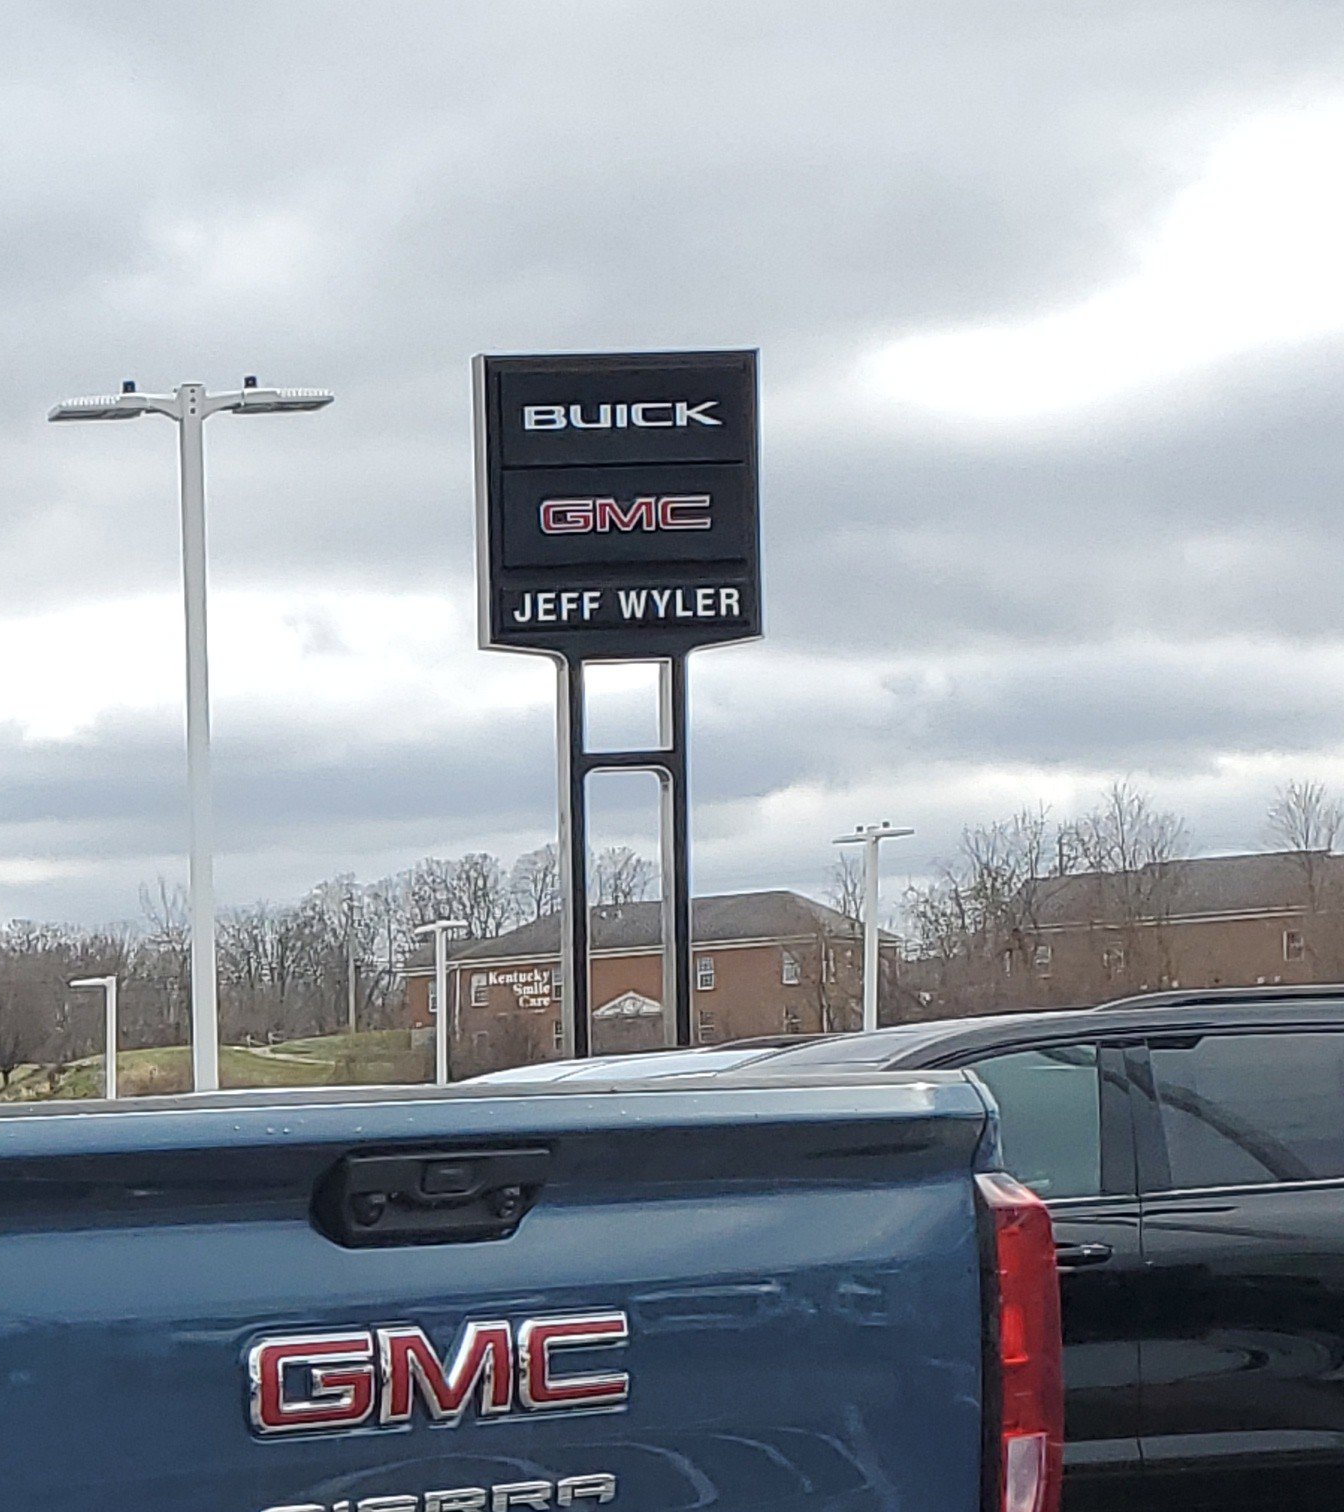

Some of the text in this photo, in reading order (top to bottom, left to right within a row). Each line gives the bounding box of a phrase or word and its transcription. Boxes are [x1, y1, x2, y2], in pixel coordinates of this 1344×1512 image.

[523, 401, 722, 430] BUICK
[540, 494, 711, 534] GMC
[513, 588, 741, 622] JEFF WYLER
[488, 968, 550, 985] Kentucky
[512, 982, 551, 995] Smile
[518, 995, 551, 1008] Care
[248, 1310, 630, 1433] GMC
